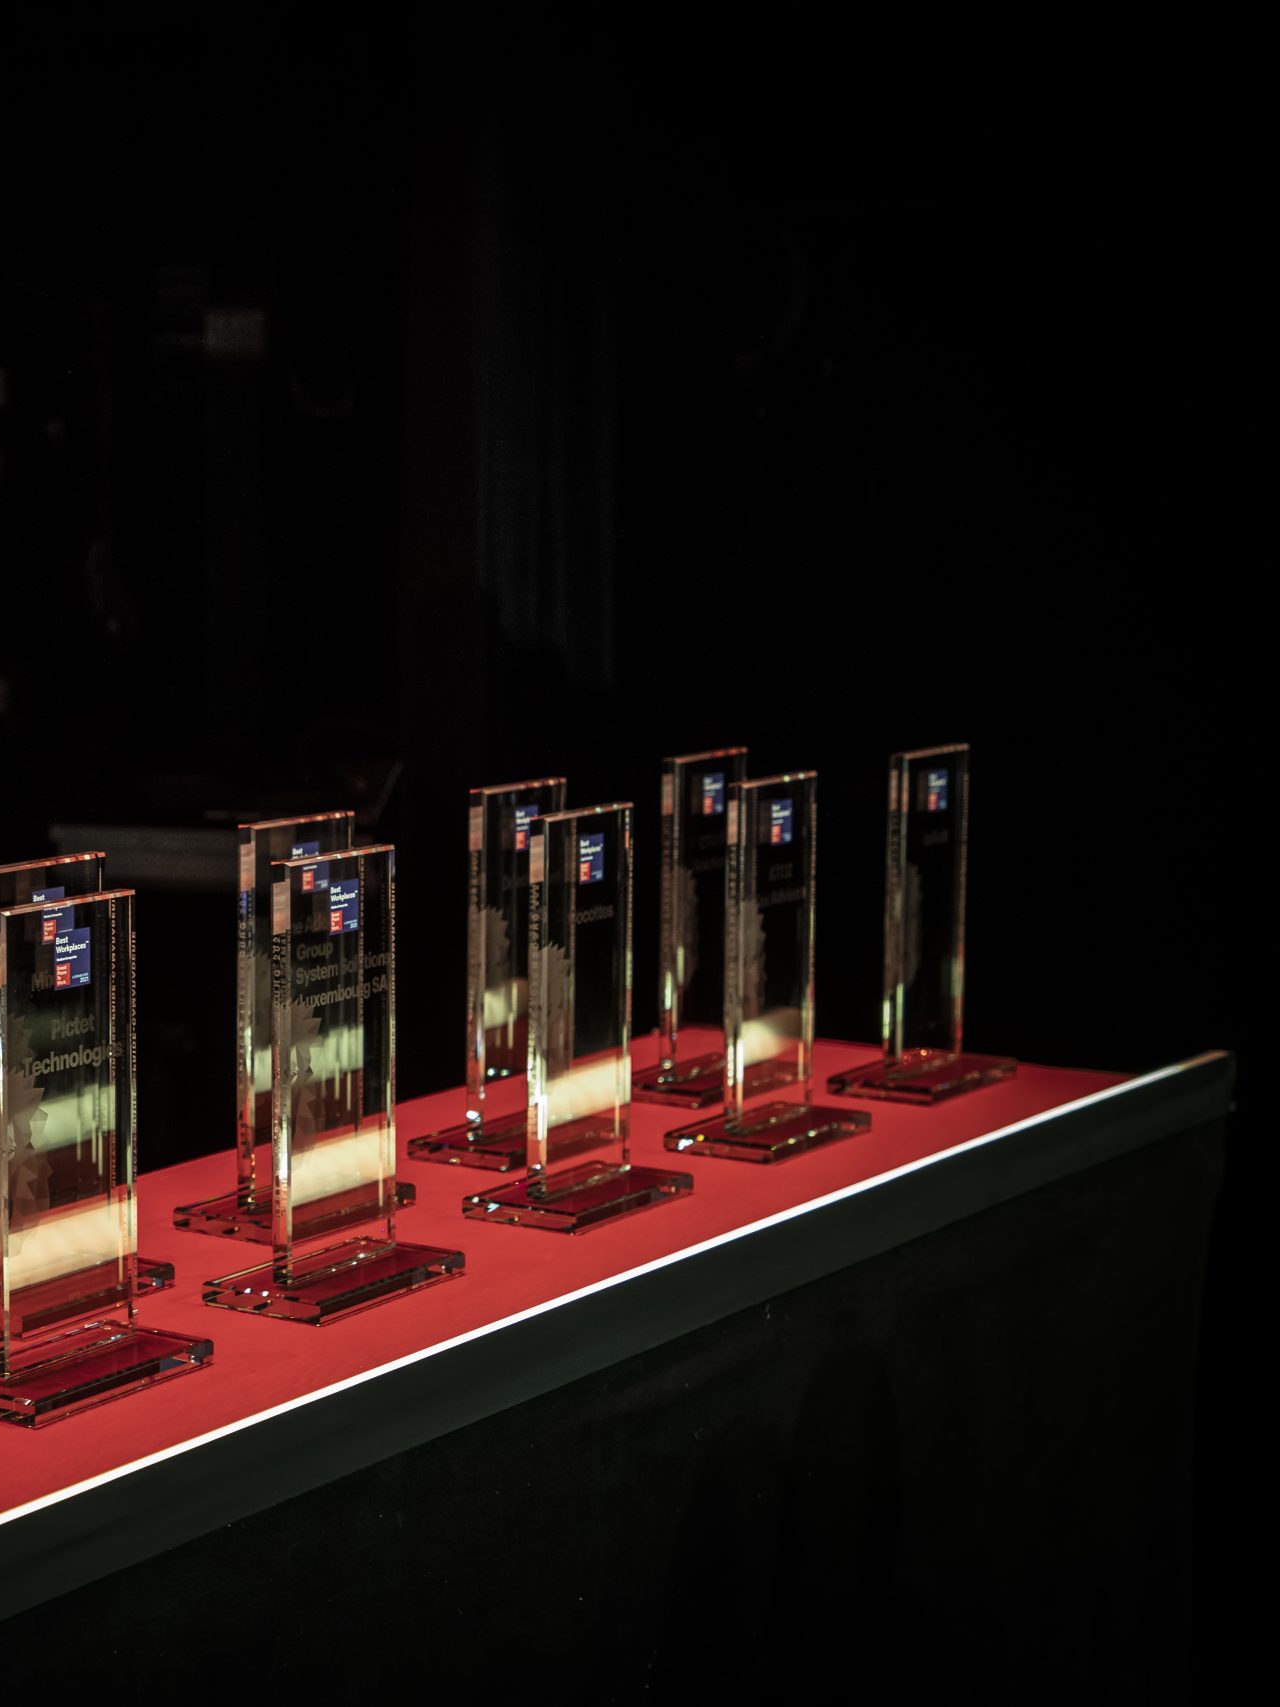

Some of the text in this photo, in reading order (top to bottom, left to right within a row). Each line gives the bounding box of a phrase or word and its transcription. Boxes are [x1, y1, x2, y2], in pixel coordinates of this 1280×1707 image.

[55, 936, 69, 945] Best
[296, 942, 334, 961] Group
[296, 963, 339, 987] System
[300, 983, 371, 1007] Luxembourg
[372, 973, 387, 993] SA
[50, 1014, 95, 1040] Pictet
